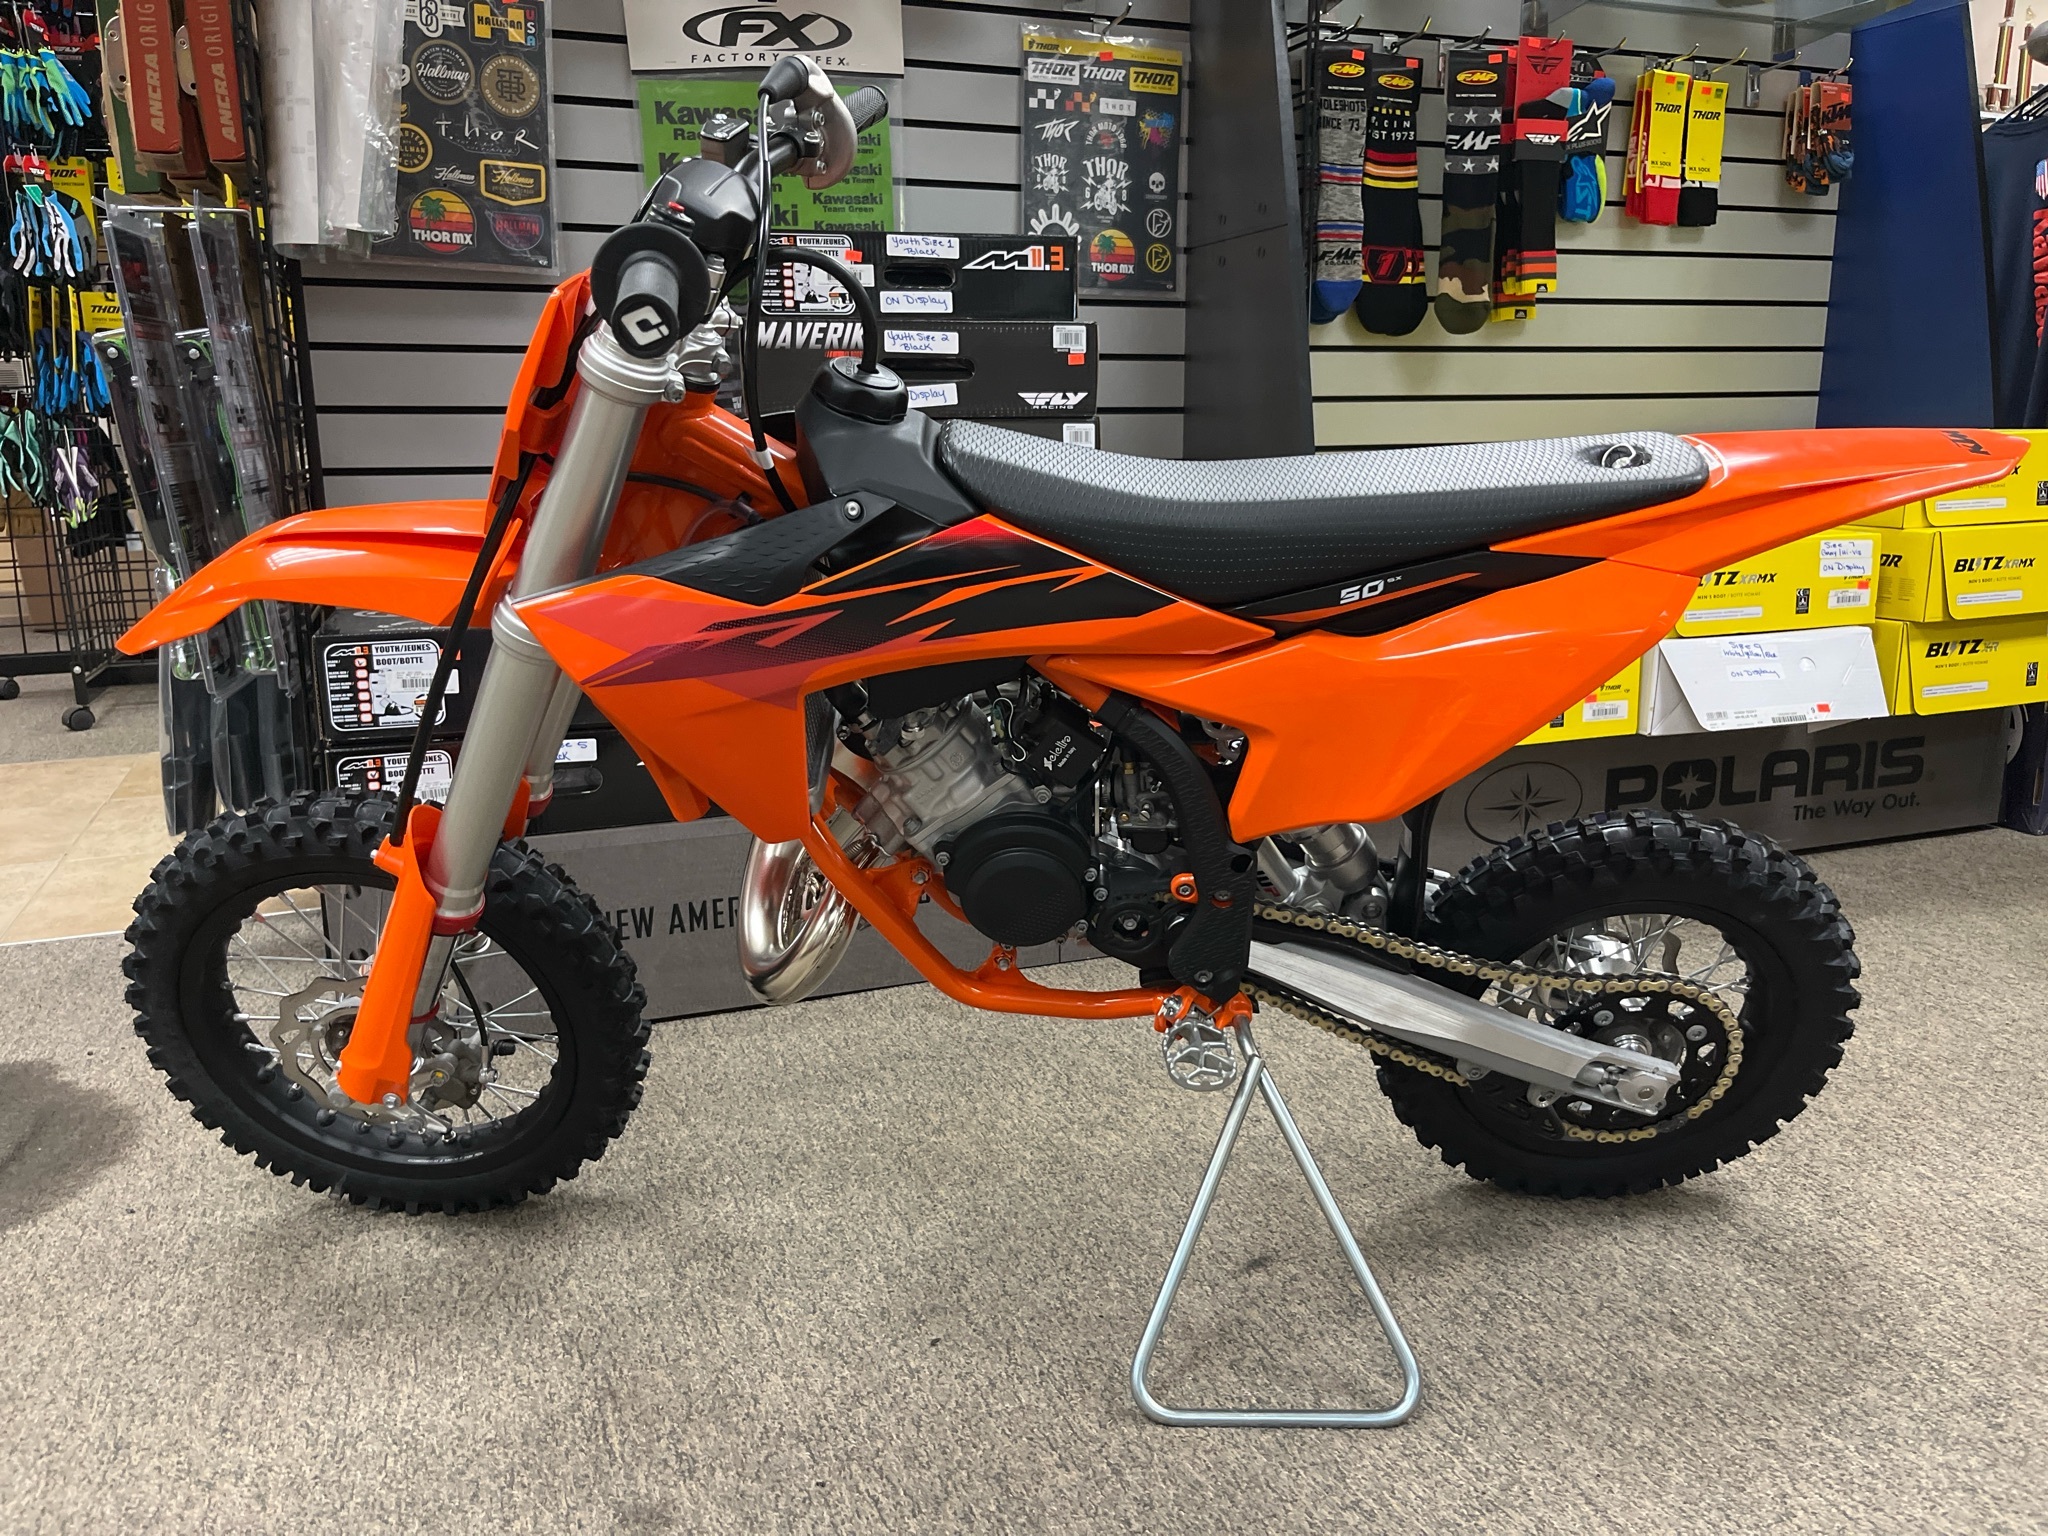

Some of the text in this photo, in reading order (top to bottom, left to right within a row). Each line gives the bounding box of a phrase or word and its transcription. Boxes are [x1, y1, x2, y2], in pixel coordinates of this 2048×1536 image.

[720, 12, 822, 50] FX
[1035, 42, 1060, 51] THOR
[691, 52, 780, 64] FACTORY
[416, 62, 470, 82] Hallman
[1030, 61, 1075, 76] THOR
[1083, 65, 1127, 81] THOR
[1329, 64, 1365, 74] FMF
[1133, 70, 1175, 86] THOR
[1378, 77, 1414, 87] FMF
[1457, 72, 1498, 81] FMF
[143, 53, 167, 135] ANCRA
[213, 62, 237, 144] ANCRA
[1655, 102, 1682, 114] THOR
[1320, 116, 1341, 129] INCE
[1693, 110, 1721, 121] THOR
[1391, 131, 1415, 141] 1973
[1035, 153, 1067, 169] THOR
[1082, 156, 1129, 179] THOR
[812, 192, 883, 205] Kawasaki
[822, 205, 874, 213] Team Green
[814, 220, 885, 232] Kawasaki
[412, 229, 451, 244] THOR
[798, 237, 846, 246] YOUTH/JEUNES
[891, 236, 954, 249] Youth Size 1
[903, 247, 940, 257] Black
[1320, 247, 1362, 260] FMF
[1091, 262, 1135, 274] THOR MX
[903, 294, 948, 311] Display
[757, 322, 864, 350] MAVERIK
[887, 331, 949, 346] Youth Size 2
[900, 343, 933, 351] Black
[909, 388, 947, 404] Display
[1022, 392, 1089, 406] FLY
[1880, 553, 1903, 568] OR
[1953, 556, 2006, 574] BLITZ
[1835, 561, 1865, 575] Display
[1340, 579, 1384, 605] 50
[374, 643, 431, 653] YOUTH/JEUNES
[1925, 638, 1984, 658] BLITZ
[375, 656, 424, 666] BOOT/BOTTE
[577, 741, 588, 749] 5
[1604, 736, 1926, 812] POLARIS
[1793, 791, 1921, 822] The Way Out.
